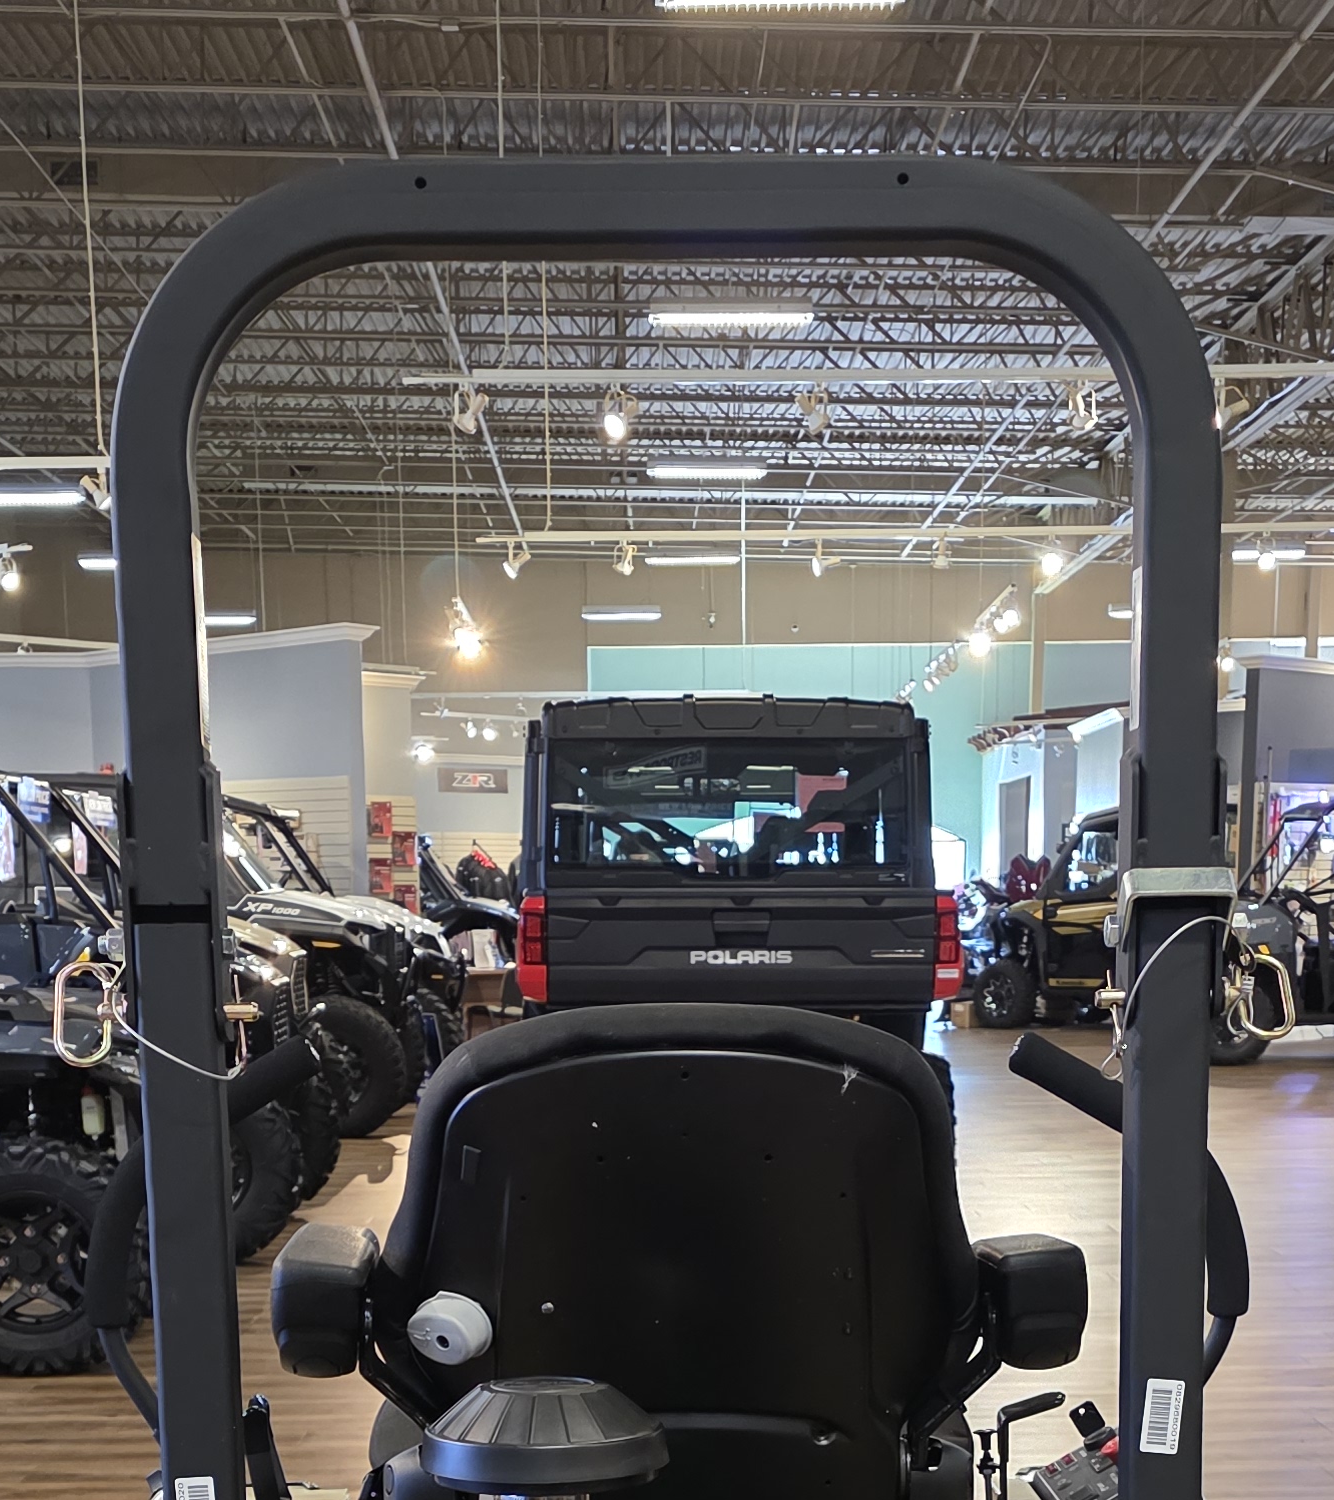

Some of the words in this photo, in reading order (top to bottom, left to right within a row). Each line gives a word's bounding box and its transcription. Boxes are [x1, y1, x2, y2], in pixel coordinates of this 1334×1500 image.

[242, 901, 273, 913] XP
[271, 906, 302, 917] 1000
[689, 950, 793, 965] POLARIS
